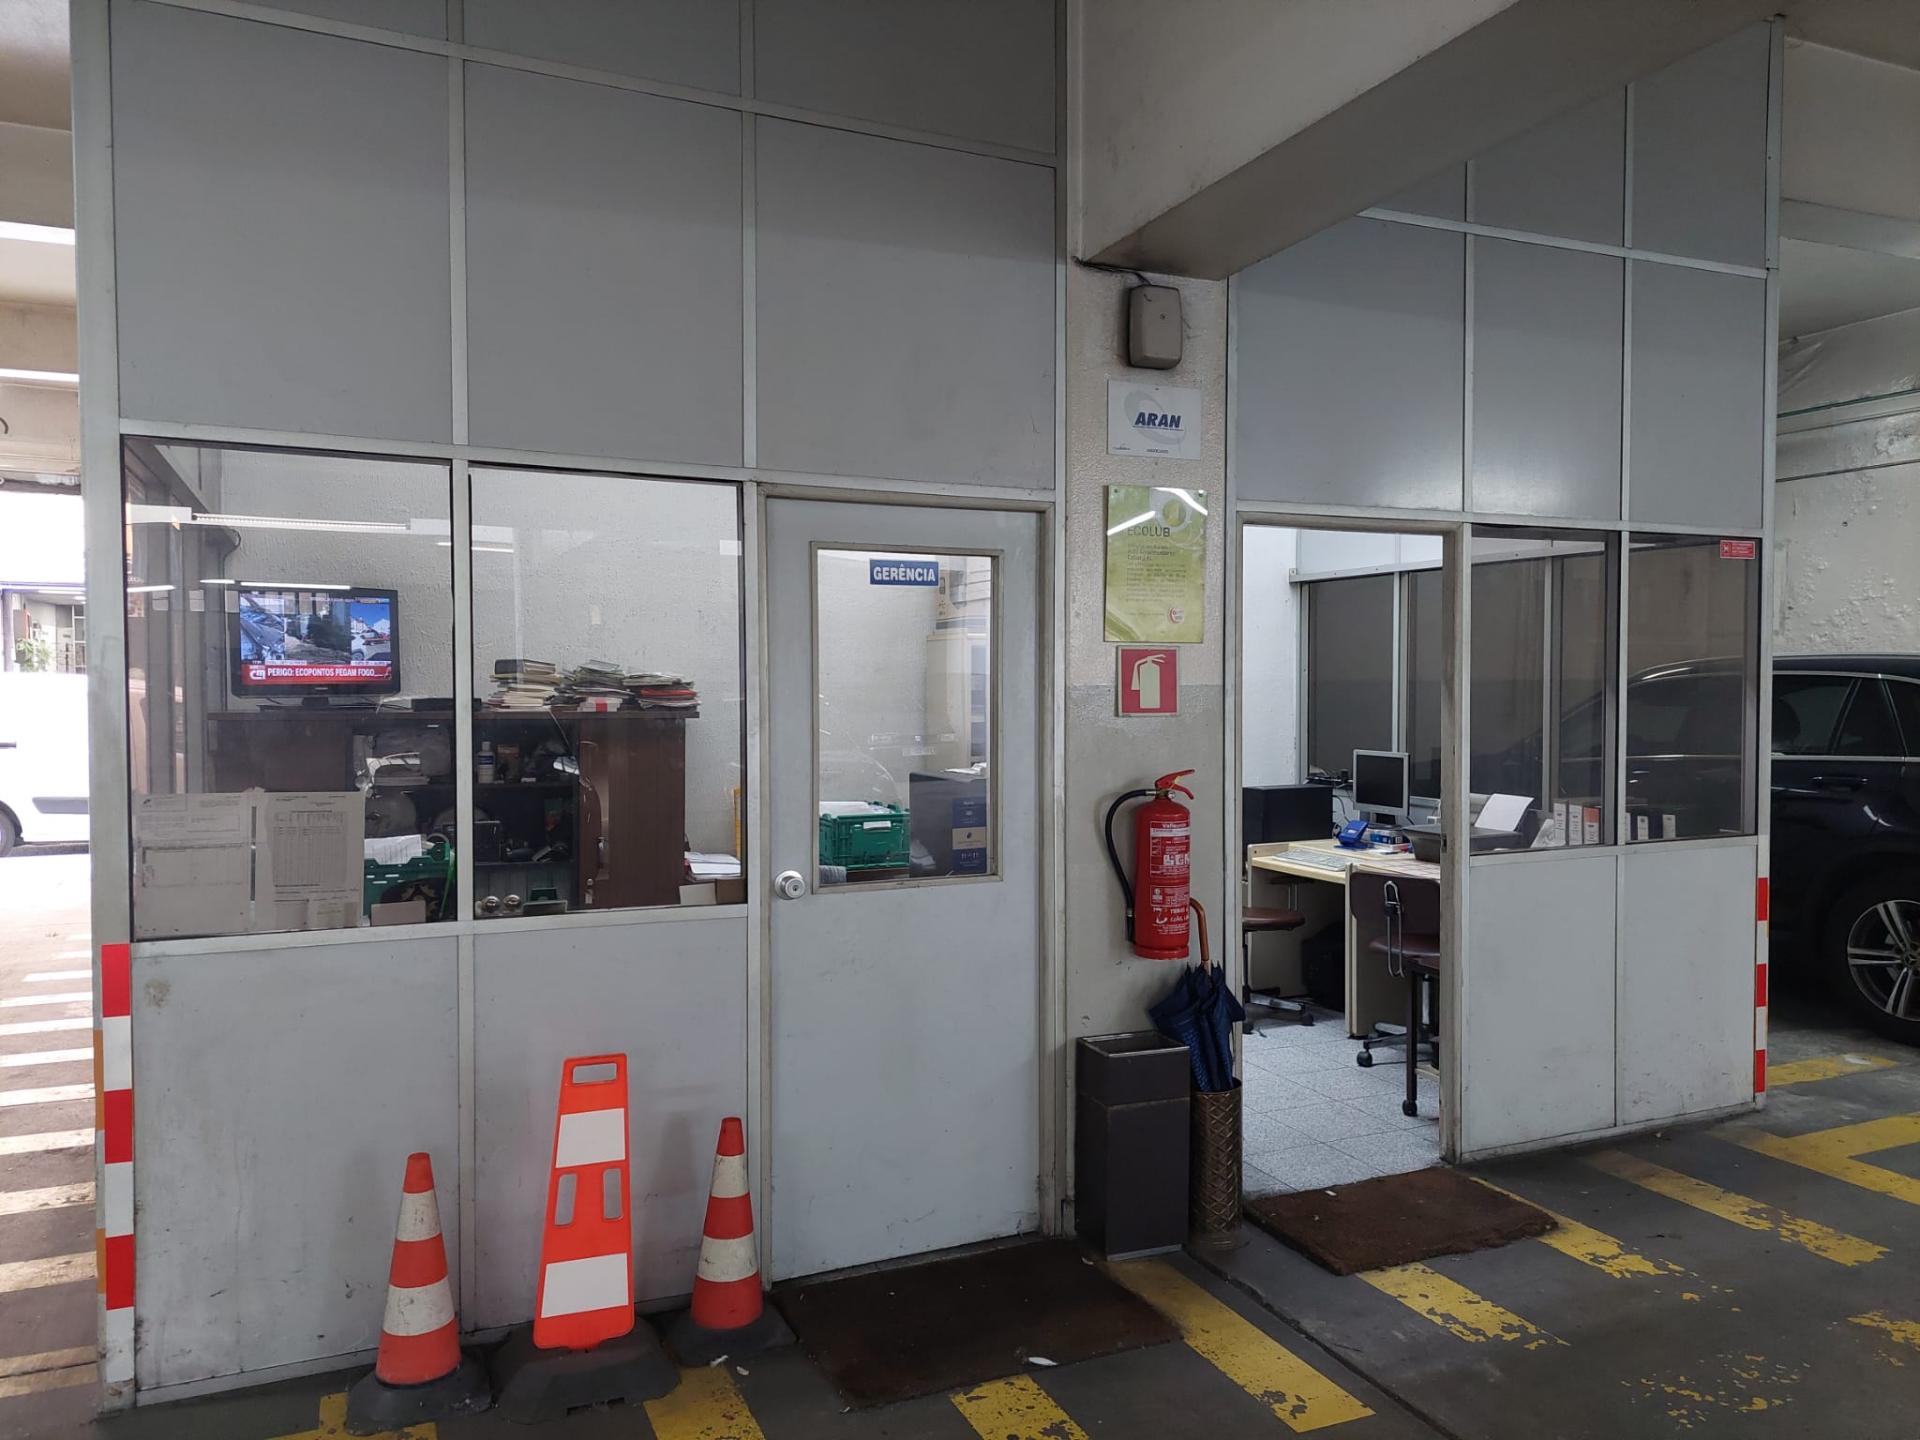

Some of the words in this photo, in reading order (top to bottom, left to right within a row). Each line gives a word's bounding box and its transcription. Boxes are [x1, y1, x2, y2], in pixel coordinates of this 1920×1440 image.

[1134, 411, 1182, 428] ARAN
[1127, 525, 1170, 537] ECOLUB
[873, 563, 936, 582] GERÊNCIA
[295, 667, 334, 677] ECOPONTOS
[335, 667, 357, 676] PEGAM
